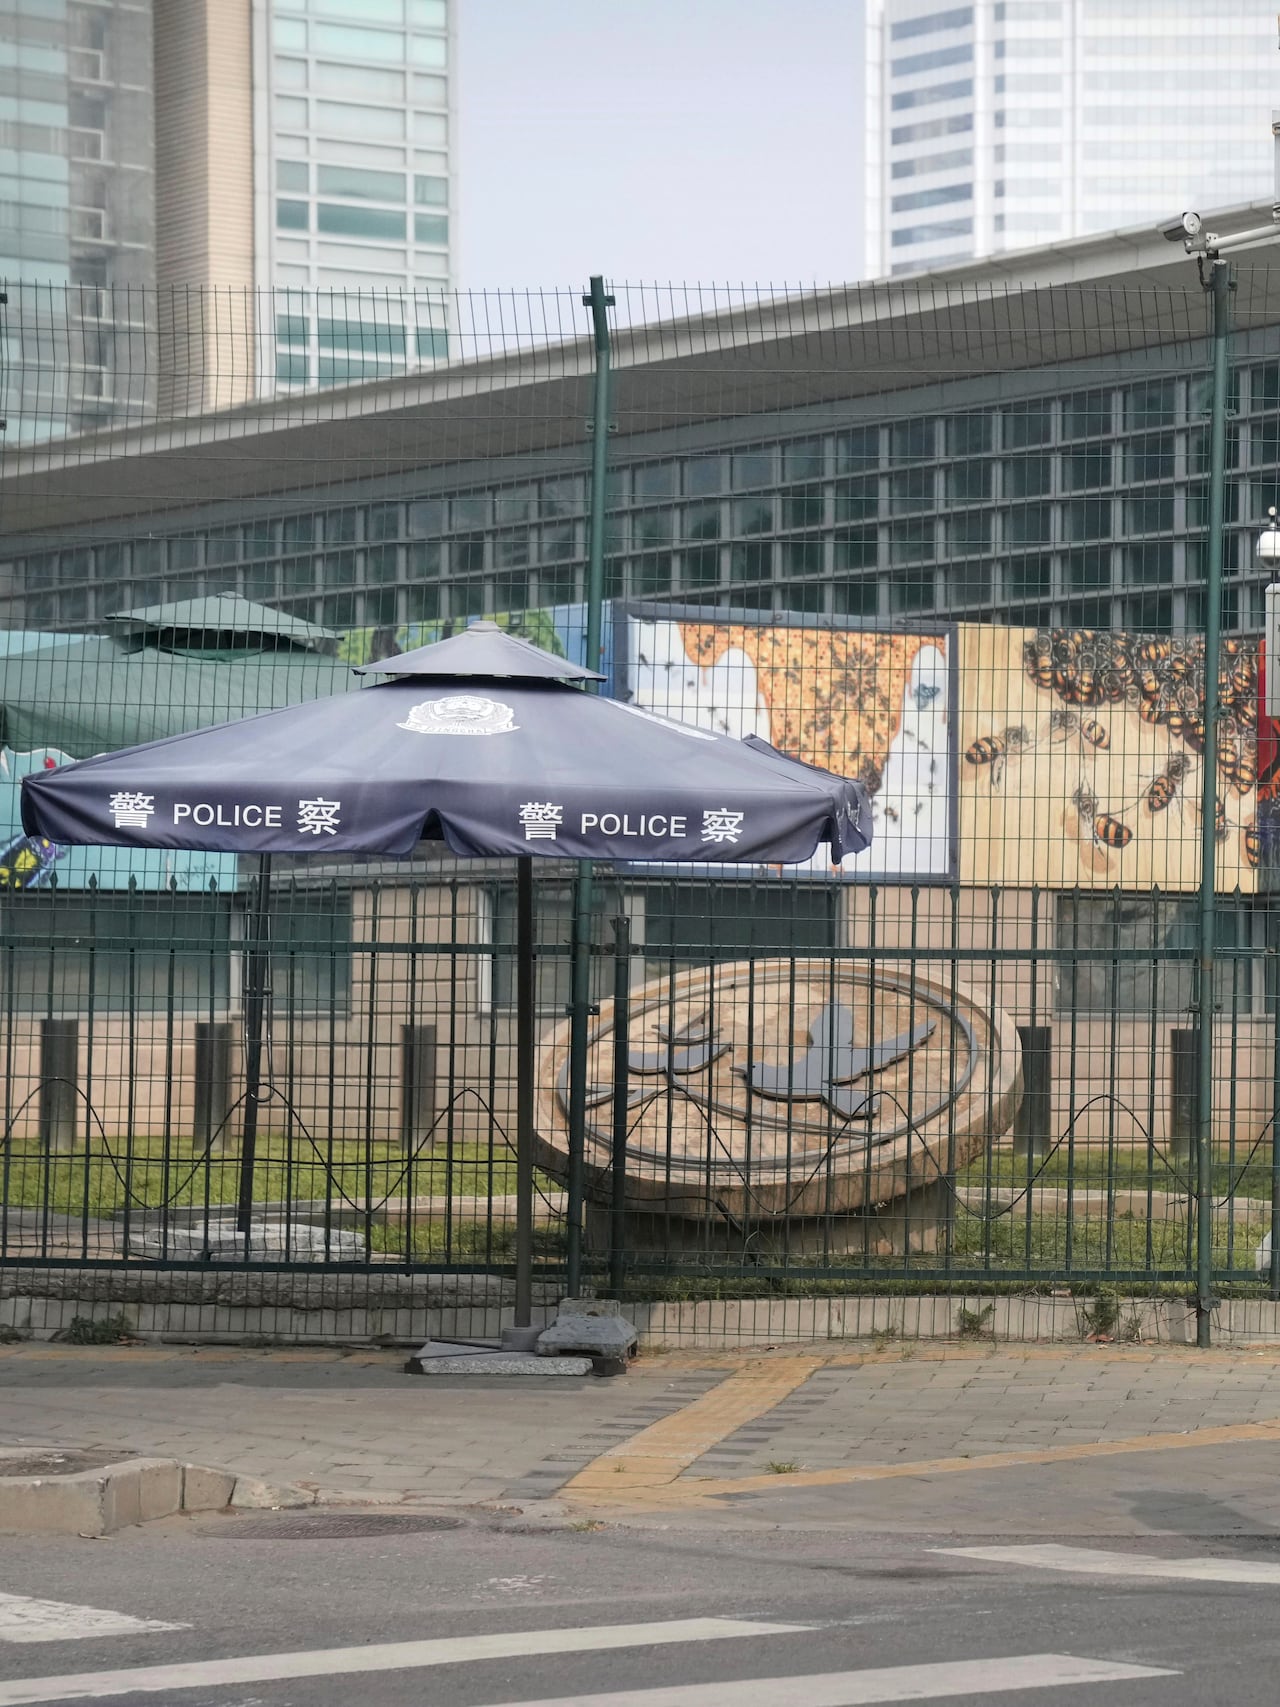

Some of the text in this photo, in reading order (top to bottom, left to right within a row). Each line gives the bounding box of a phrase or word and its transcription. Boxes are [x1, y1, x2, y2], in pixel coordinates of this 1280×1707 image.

[109, 792, 341, 835] 警 POLICE 察
[519, 802, 744, 843] 警 POLICE 察
